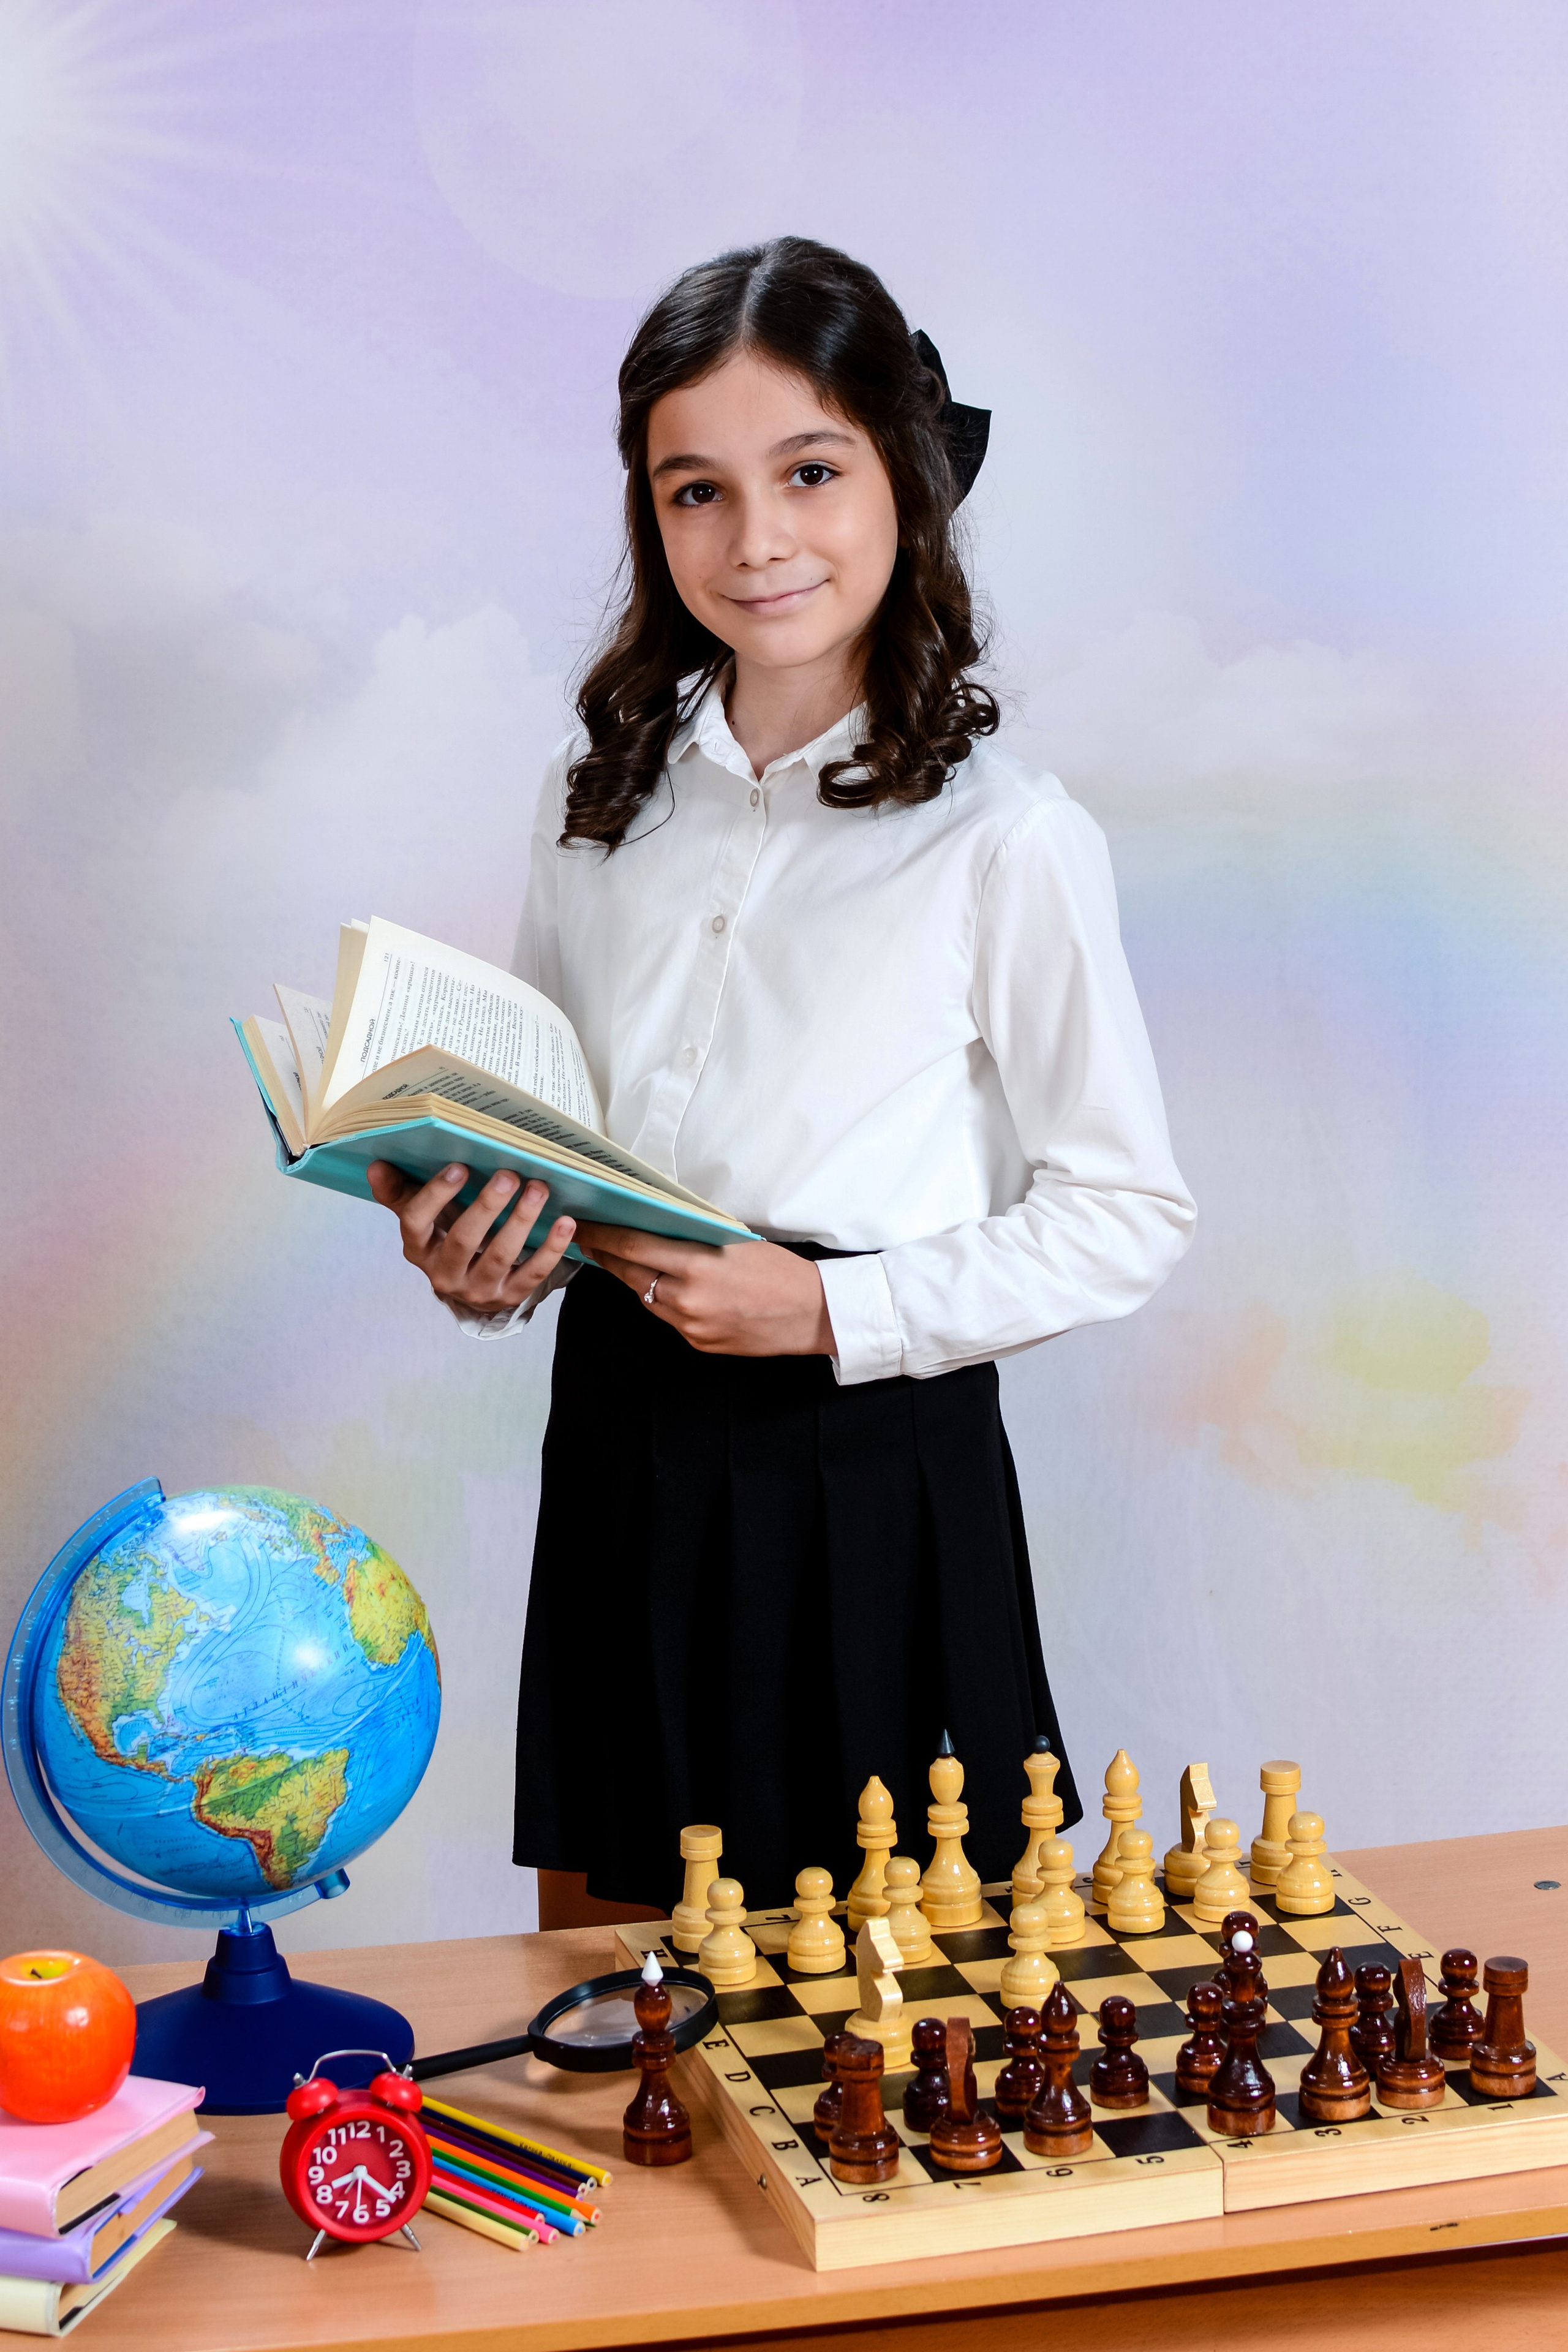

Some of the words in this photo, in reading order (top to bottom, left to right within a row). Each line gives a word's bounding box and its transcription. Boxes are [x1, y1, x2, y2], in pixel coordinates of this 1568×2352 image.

[426, 969, 435, 1005] процентов
[440, 975, 449, 1001] Короче,
[469, 984, 475, 995] Но
[452, 1017, 457, 1025] не
[477, 1026, 484, 1036] Не
[482, 989, 488, 1002] Мы
[378, 1007, 391, 1045] бизнесмен,
[360, 1018, 375, 1063] ПОДСАДНОЙ
[376, 1046, 382, 1054] не
[1348, 1897, 1371, 1905] G
[1408, 1951, 1434, 1959] E
[702, 2039, 729, 2049] E
[725, 2070, 751, 2082] D
[749, 2106, 776, 2116] C
[328, 2128, 346, 2146] 11
[347, 2120, 371, 2139] 12
[376, 2125, 385, 2143] 1
[389, 2139, 404, 2158] 2
[771, 2139, 799, 2150] B
[862, 2193, 890, 2203] 8
[1136, 2155, 1164, 2165] 5
[1227, 2139, 1253, 2149] 4
[1314, 2127, 1342, 2138] 3
[1401, 2115, 1430, 2125] 2
[1487, 2103, 1513, 2112] 1
[312, 2146, 337, 2165] 10
[308, 2166, 325, 2185] 9
[396, 2160, 411, 2179] 3
[388, 2180, 405, 2199] 4
[796, 2176, 823, 2187] A
[316, 2185, 333, 2204] 8
[335, 2200, 349, 2219] 7
[353, 2204, 370, 2224] 6
[375, 2198, 391, 2217] 5
